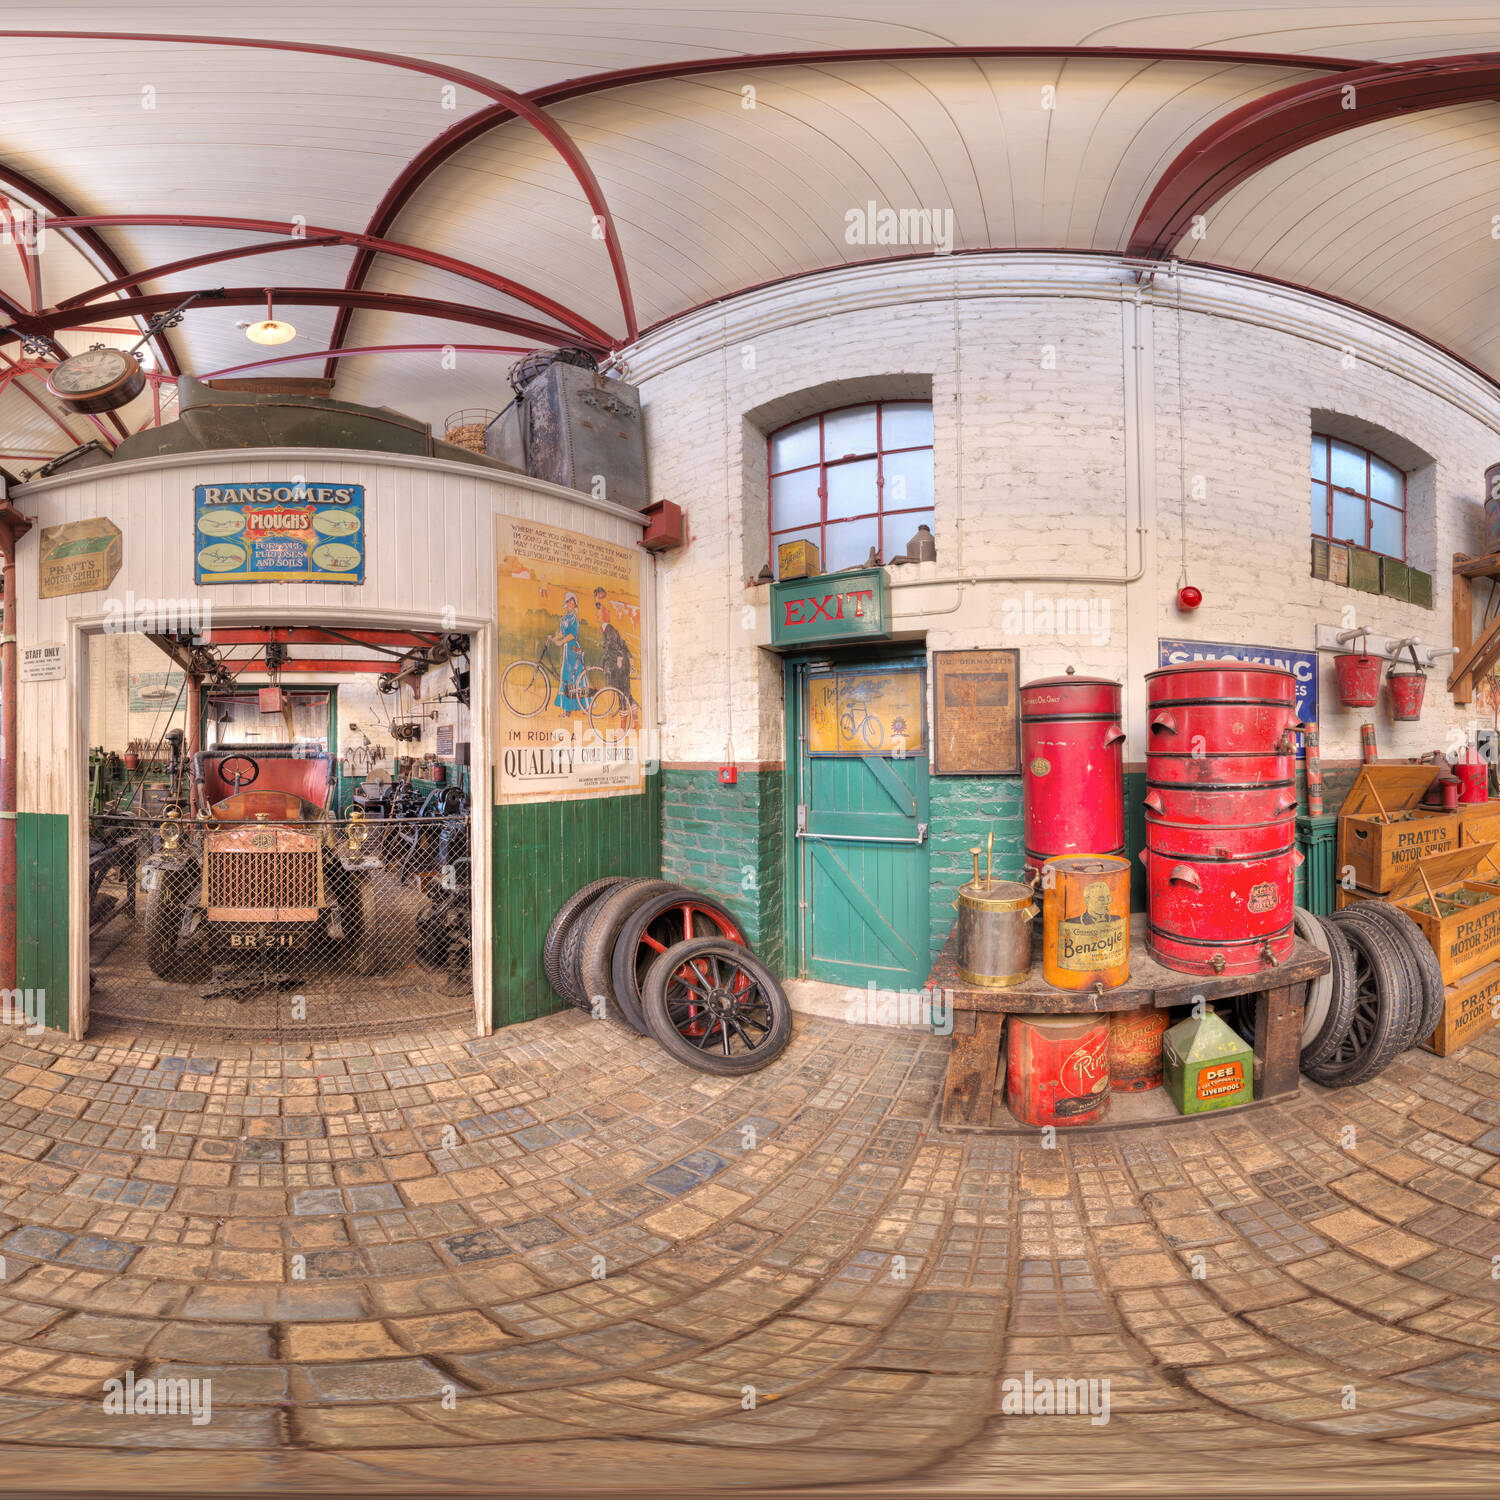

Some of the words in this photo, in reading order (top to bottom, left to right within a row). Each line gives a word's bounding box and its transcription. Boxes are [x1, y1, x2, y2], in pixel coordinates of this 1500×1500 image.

[204, 488, 355, 505] RANSOMES'
[251, 513, 309, 531] PLOUGHS
[256, 559, 274, 567] AND
[276, 559, 303, 568] SOILS
[72, 569, 102, 582] SPIRIT
[784, 590, 872, 627] EXIT
[25, 649, 43, 660] STAFF
[44, 647, 60, 658] ONLY
[527, 731, 564, 741] RIDING
[571, 731, 577, 741] A
[504, 748, 575, 778] QUALITY
[581, 748, 601, 762] CYCLE
[606, 747, 633, 762] SUPPLIED
[1399, 827, 1447, 848] PRATT'S
[1392, 847, 1422, 865] MOTOR
[231, 934, 257, 947] BR
[265, 934, 293, 947] 211
[1064, 931, 1122, 959] Benzoyle
[1450, 934, 1482, 958] MOTOR
[1455, 1003, 1485, 1031] MOTOR
[1207, 1067, 1234, 1081] DEE
[1202, 1083, 1241, 1098] LIVERPOOL
